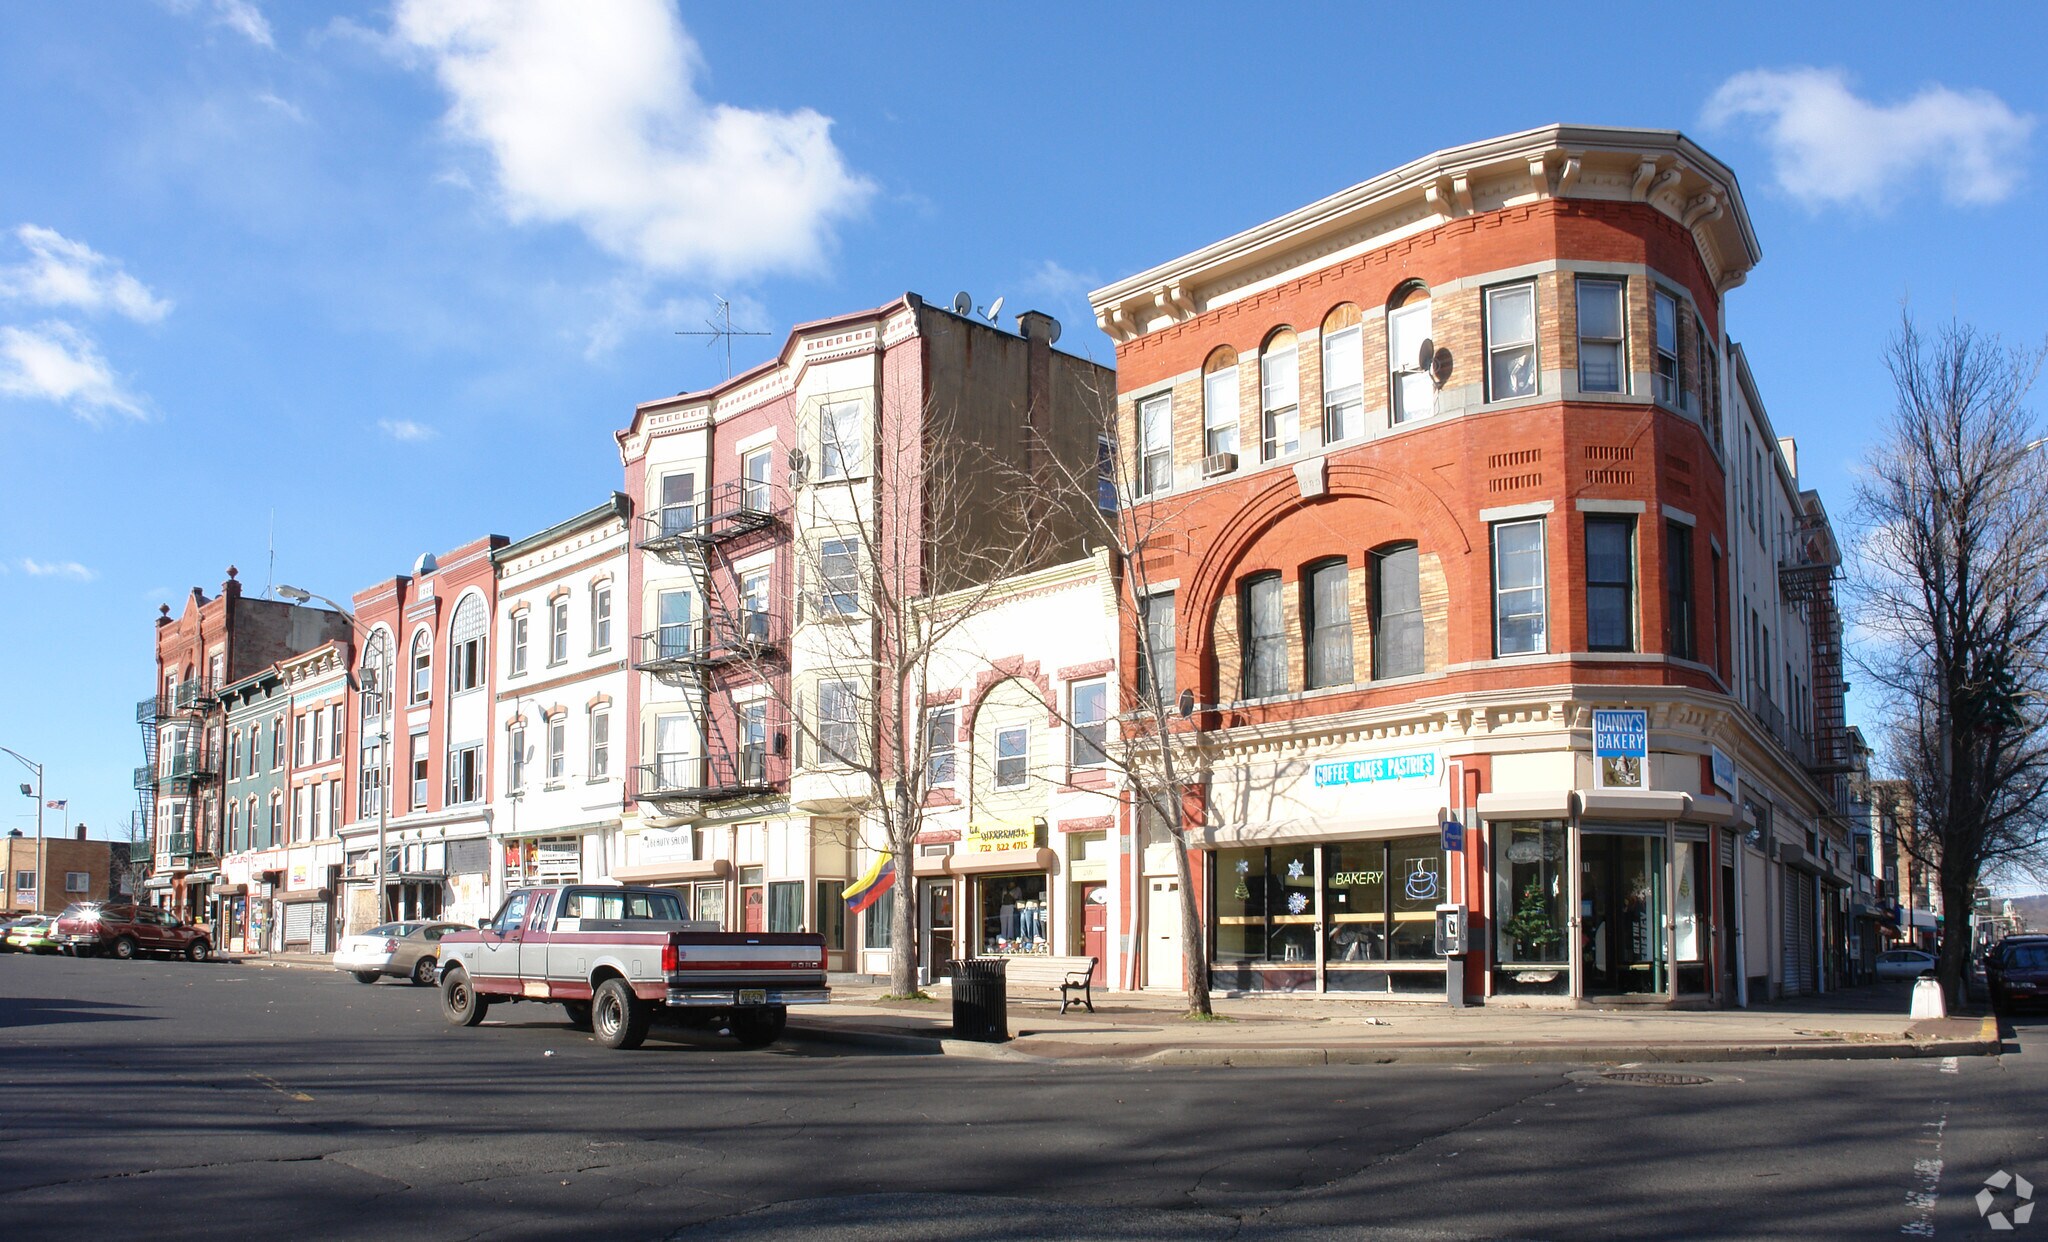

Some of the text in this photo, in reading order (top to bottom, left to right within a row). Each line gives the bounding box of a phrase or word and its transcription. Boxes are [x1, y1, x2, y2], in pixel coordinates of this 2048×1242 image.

[1597, 713, 1643, 732] DANNY'S
[1597, 733, 1644, 749] BAKERY
[1316, 754, 1433, 784] COFFEE CAKES PASTRIES
[650, 835, 689, 848] BEAUTY SALON
[980, 841, 1028, 852] 732 822 4715
[1335, 871, 1384, 885] BAKERY
